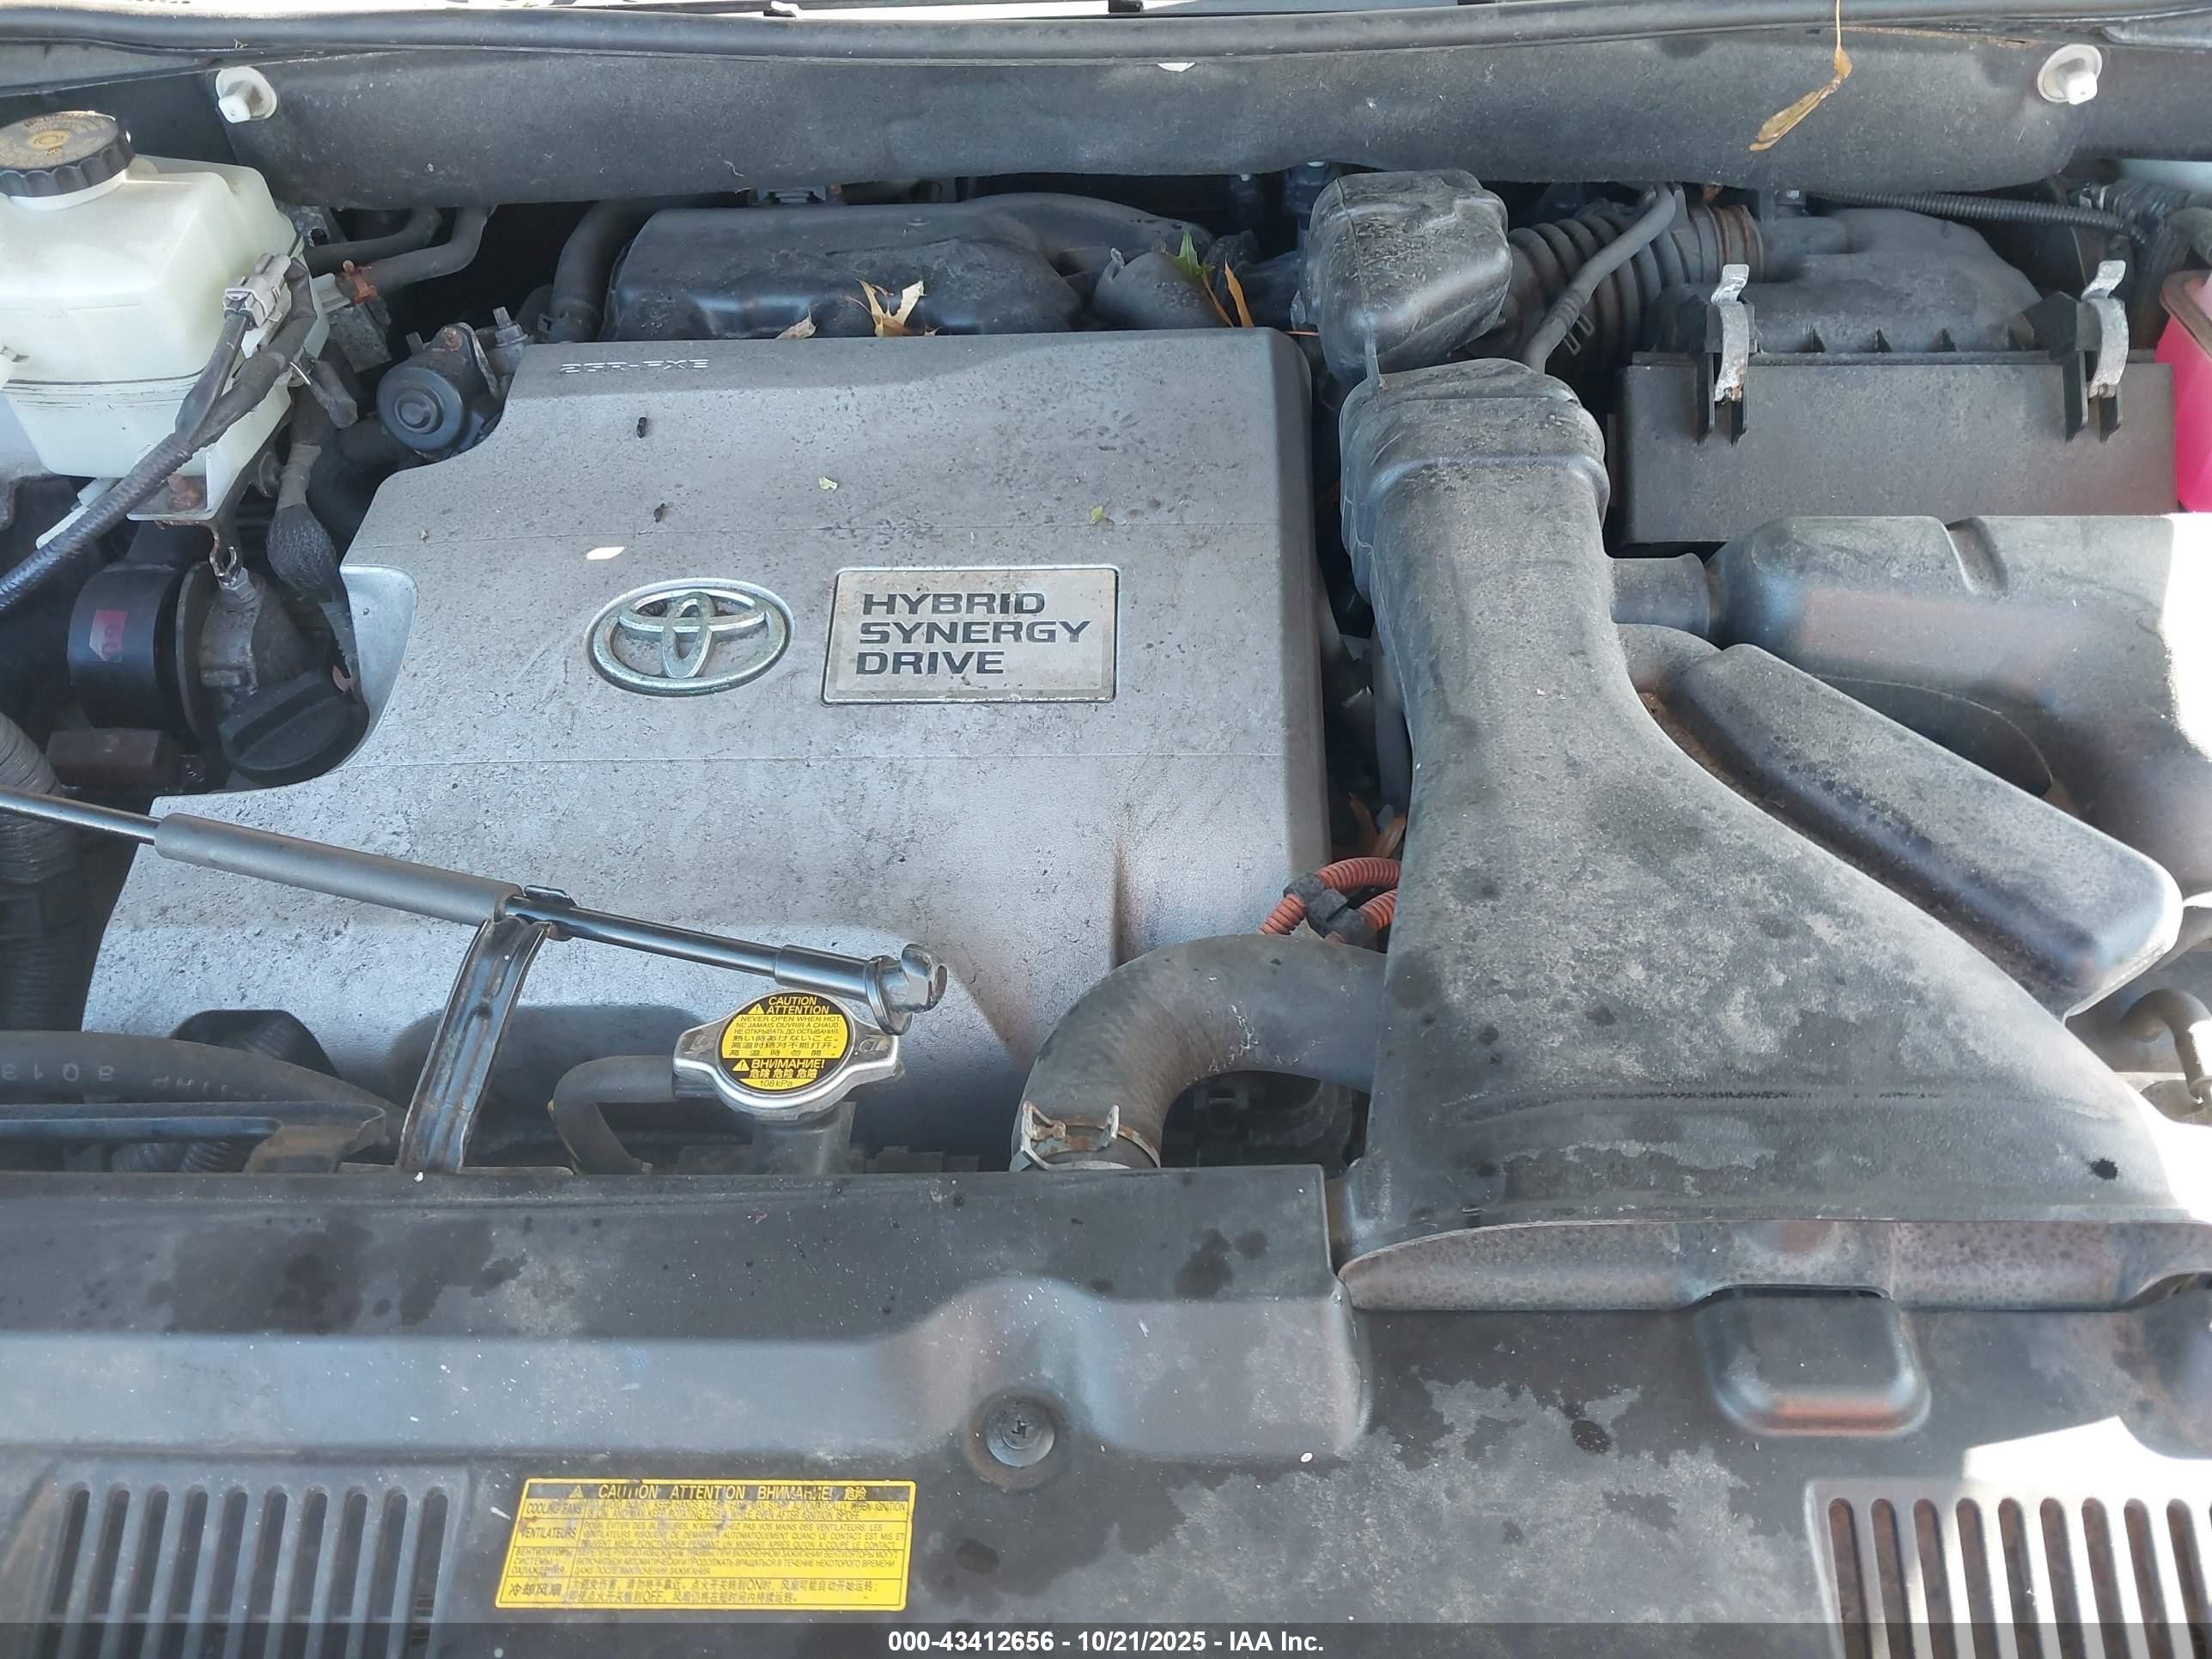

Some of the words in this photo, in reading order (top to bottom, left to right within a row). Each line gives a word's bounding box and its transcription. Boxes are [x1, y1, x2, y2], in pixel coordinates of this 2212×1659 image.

[862, 592, 1045, 615] HYBRID
[860, 621, 1091, 644] SYNERGY
[856, 651, 1005, 674] DRIVE
[769, 996, 817, 1006] CAUTION
[767, 1006, 830, 1014] ATTENTION
[750, 1059, 825, 1069] ВНИМАНИЕ!
[669, 1485, 745, 1500] ATTENTION
